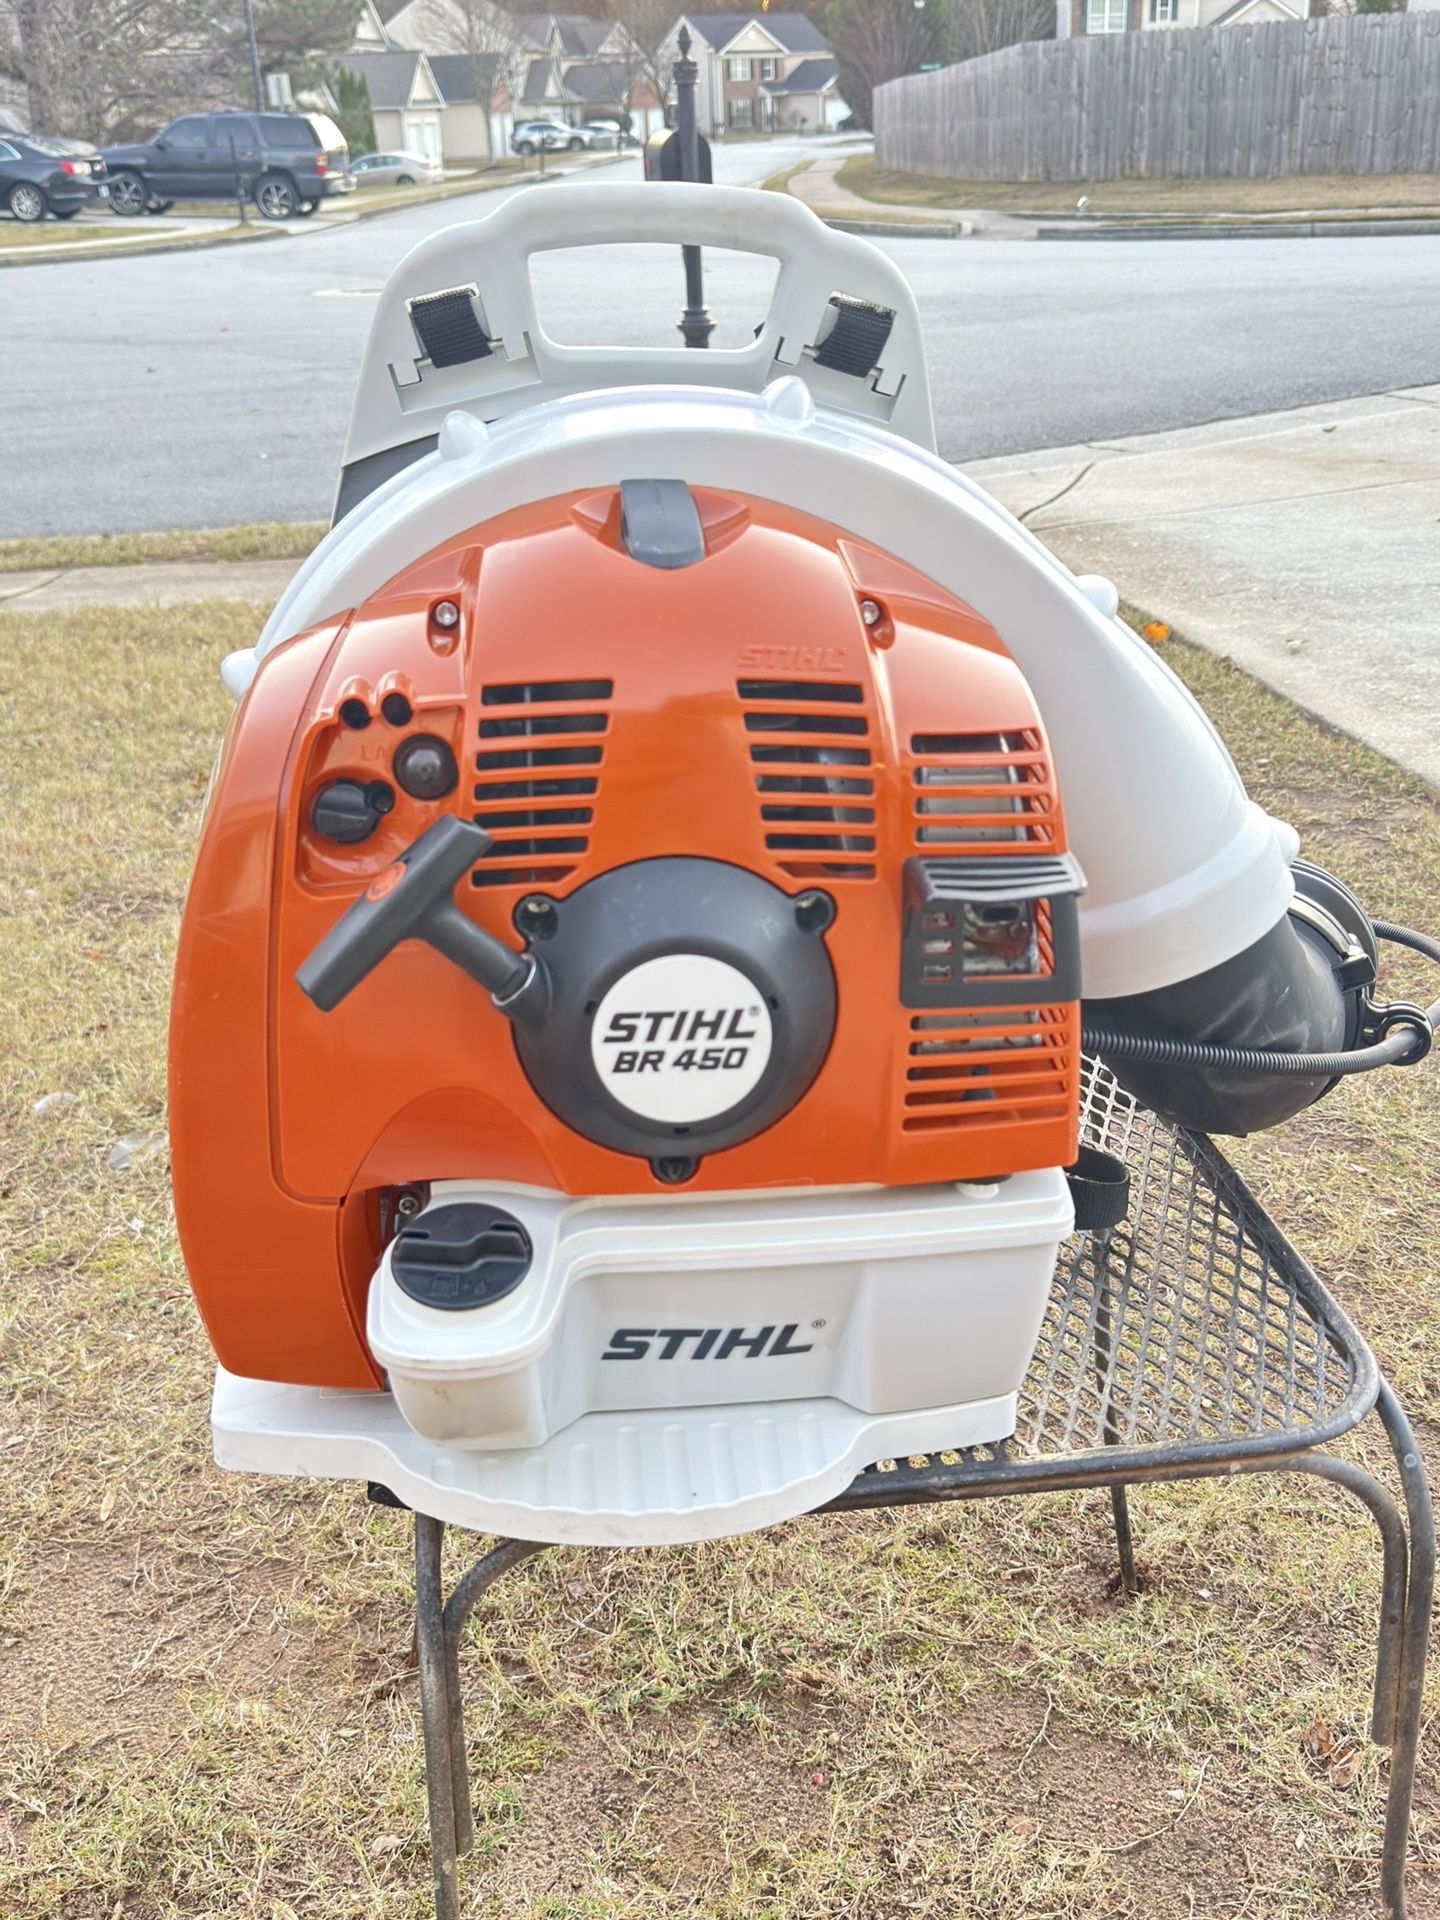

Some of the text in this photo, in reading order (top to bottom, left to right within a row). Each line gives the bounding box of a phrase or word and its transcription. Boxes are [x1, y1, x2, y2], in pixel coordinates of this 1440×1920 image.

[738, 645, 844, 673] STIHL
[612, 1047, 749, 1073] BR 450
